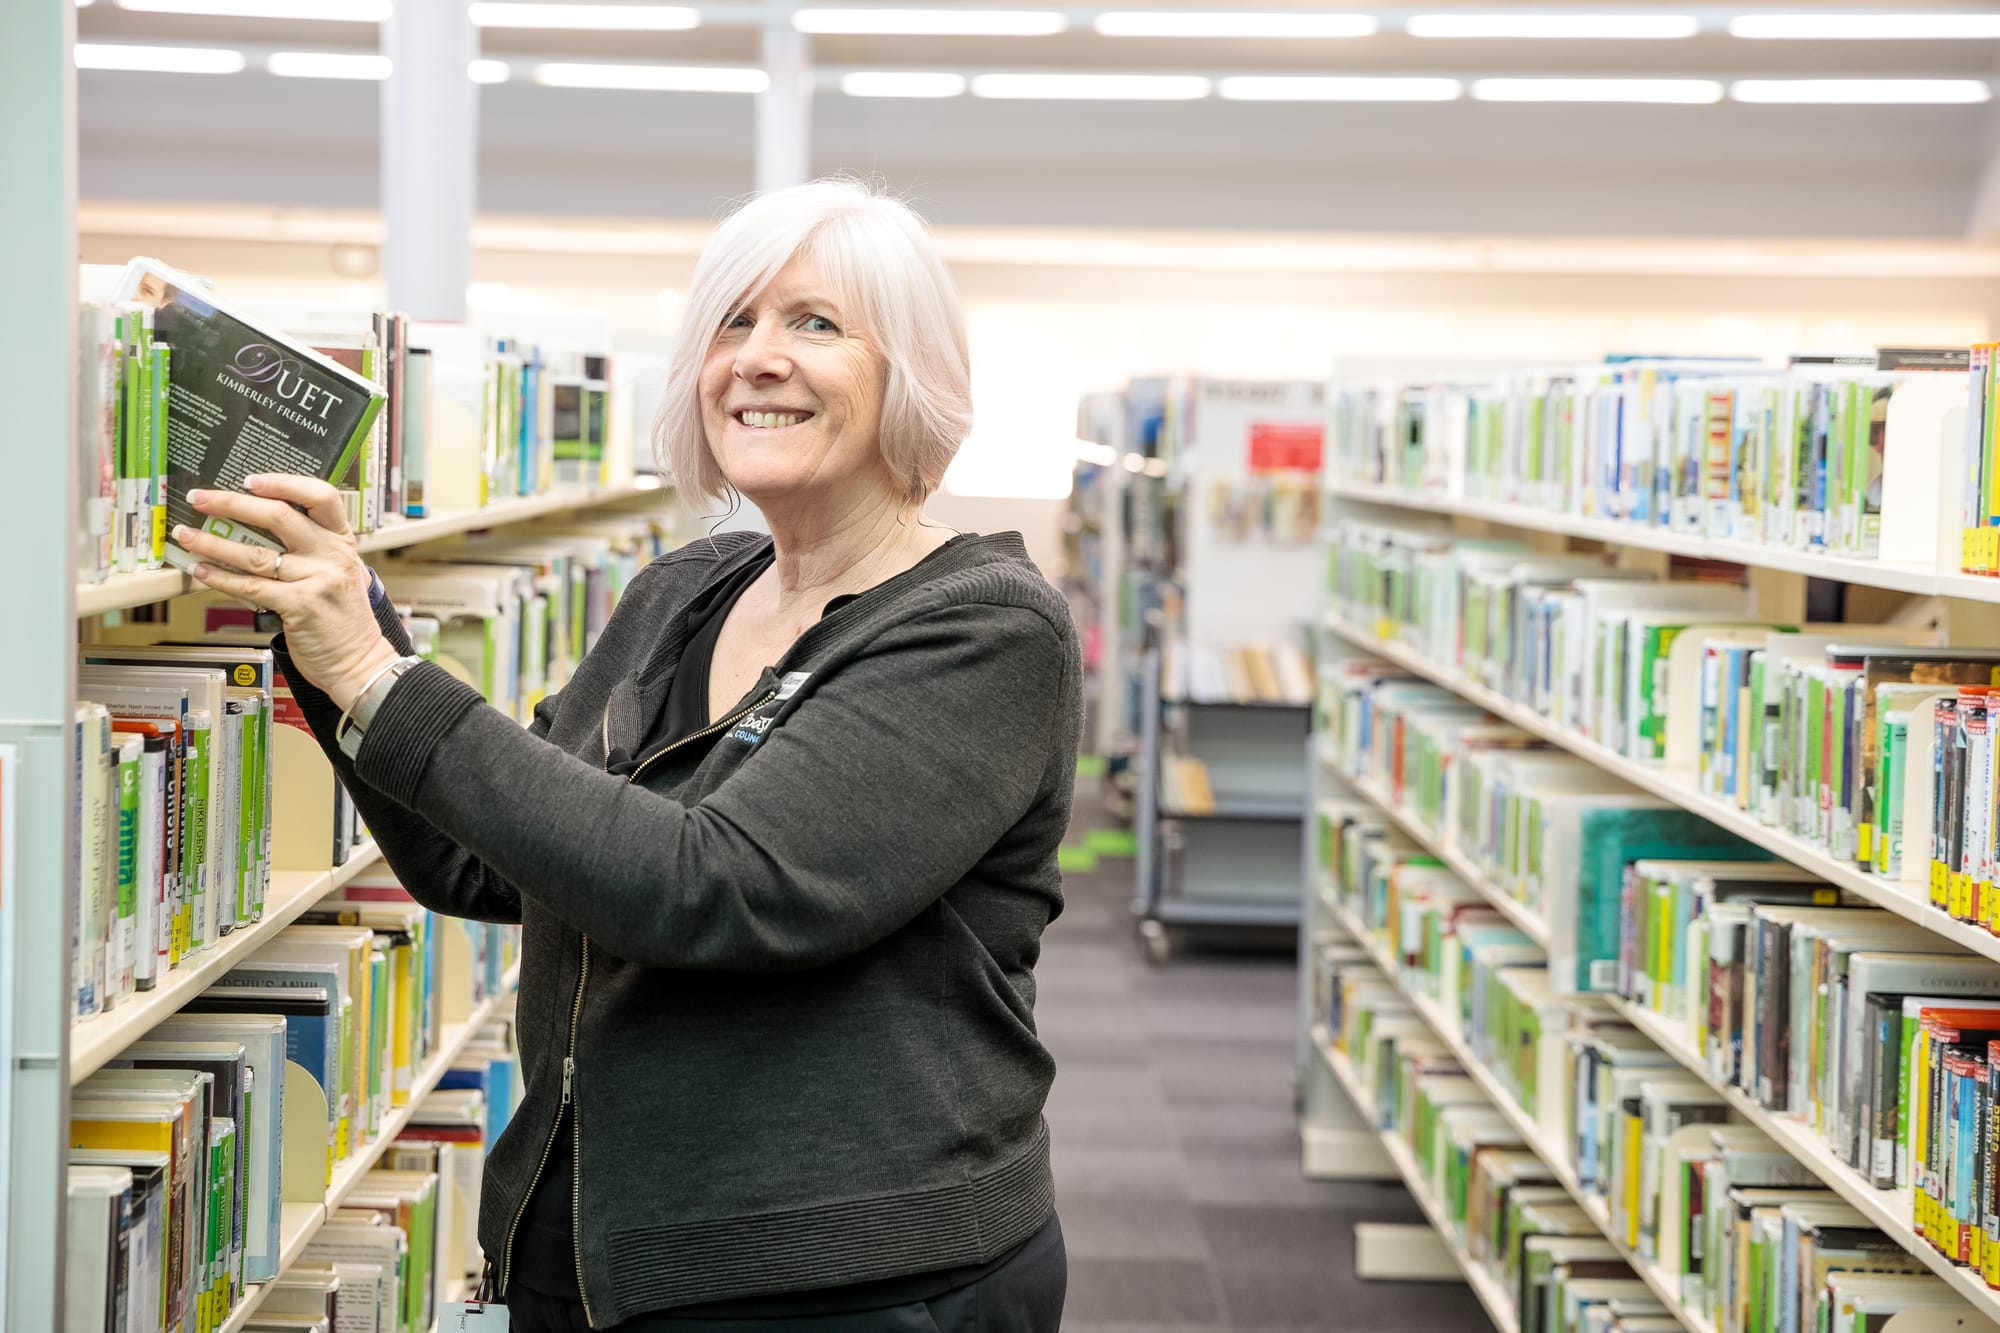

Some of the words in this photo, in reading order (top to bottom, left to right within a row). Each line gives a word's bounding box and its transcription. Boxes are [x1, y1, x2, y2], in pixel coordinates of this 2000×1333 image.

[215, 372, 277, 409] KIMBERLEY
[276, 405, 329, 438] FREEMAN
[225, 343, 343, 420] DUET
[166, 780, 177, 850] CRISIS
[196, 798, 204, 828] NIKKI
[1984, 1096, 1993, 1146] PETER
